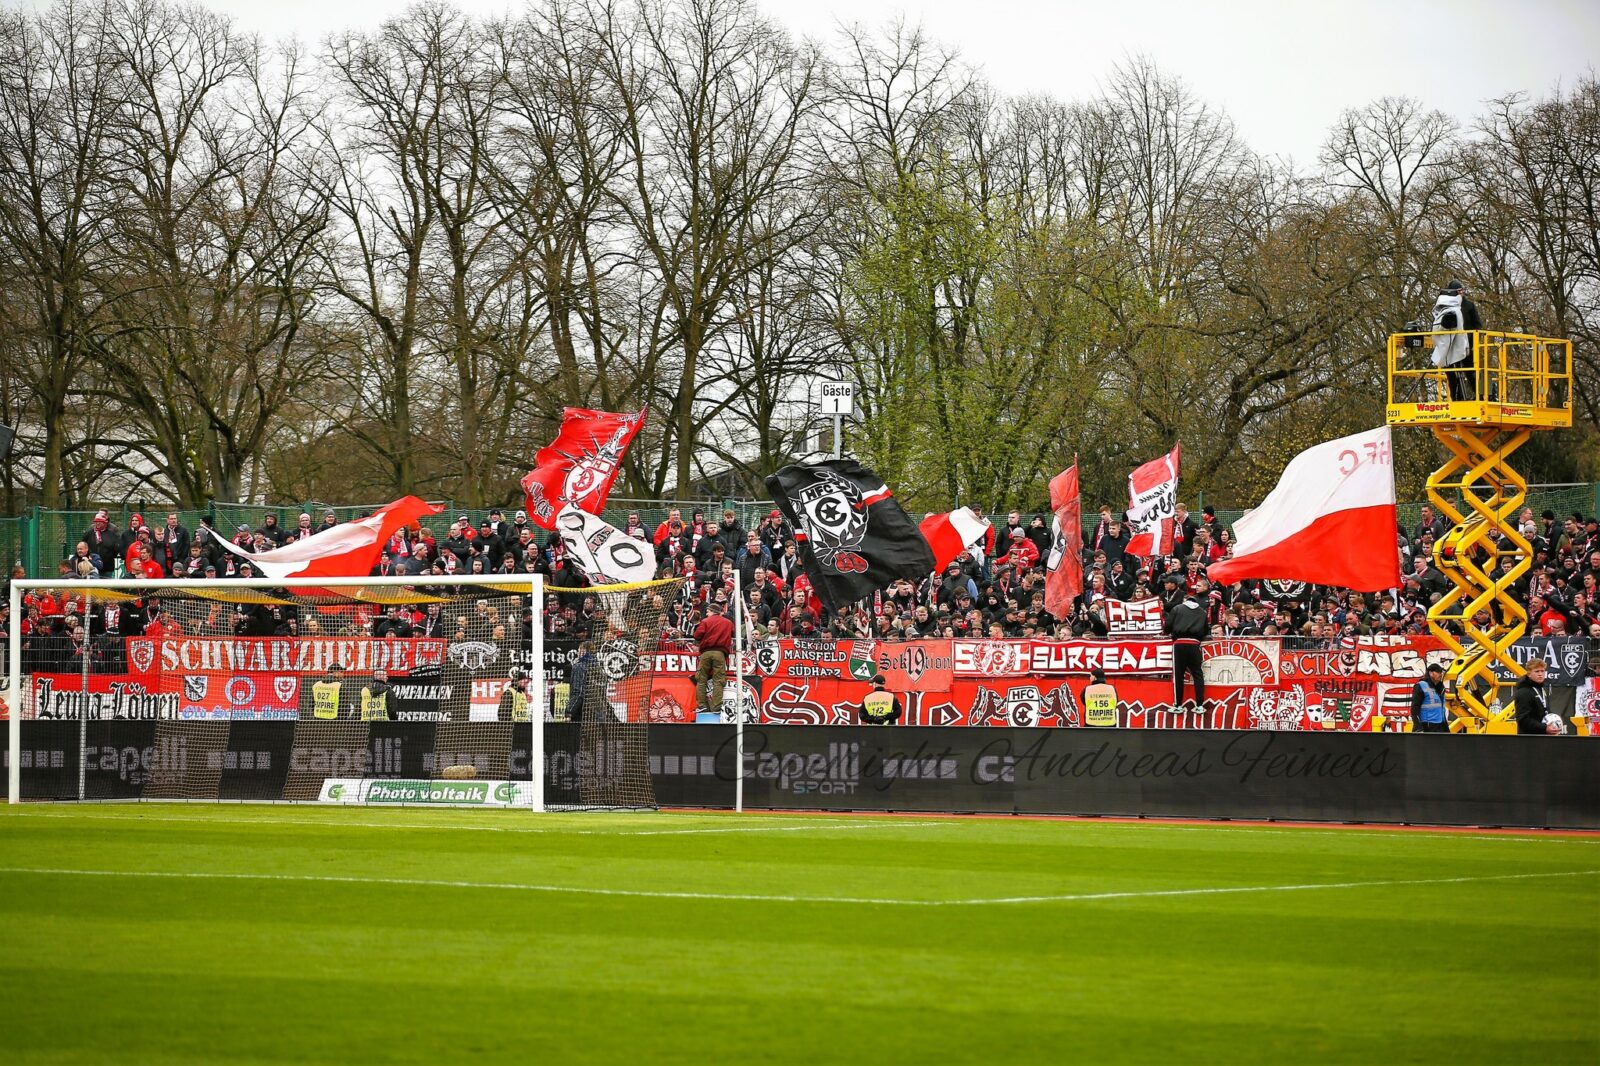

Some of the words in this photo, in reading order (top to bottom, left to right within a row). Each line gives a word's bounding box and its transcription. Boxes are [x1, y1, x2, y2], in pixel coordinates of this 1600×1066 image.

[823, 384, 851, 397] Gäste
[834, 399, 839, 412] 1
[1416, 403, 1450, 412] Wagert
[807, 484, 834, 500] HFC
[1108, 601, 1161, 621] HFC
[1109, 620, 1162, 631] CHEMIE
[795, 641, 836, 650] SEKTION
[161, 640, 409, 671] SCHWARZHEIDE
[508, 648, 566, 664] Librtà
[784, 651, 847, 662] MANSFELD
[1033, 645, 1172, 671] SURREALE
[1202, 641, 1275, 684] ATHONTOR
[788, 663, 841, 676] SÜDHARZ
[36, 677, 180, 720] Leuna-Löwen
[393, 685, 454, 700] OMFALKEN
[1012, 689, 1034, 700] HFC
[1094, 700, 1109, 708] 156
[362, 709, 386, 718] EMPIRE
[1088, 709, 1114, 717] EMPIRE
[509, 740, 625, 785] cpelli
[369, 785, 416, 799] Photo
[420, 786, 484, 801] voltaik
[792, 781, 859, 795] SPORT
